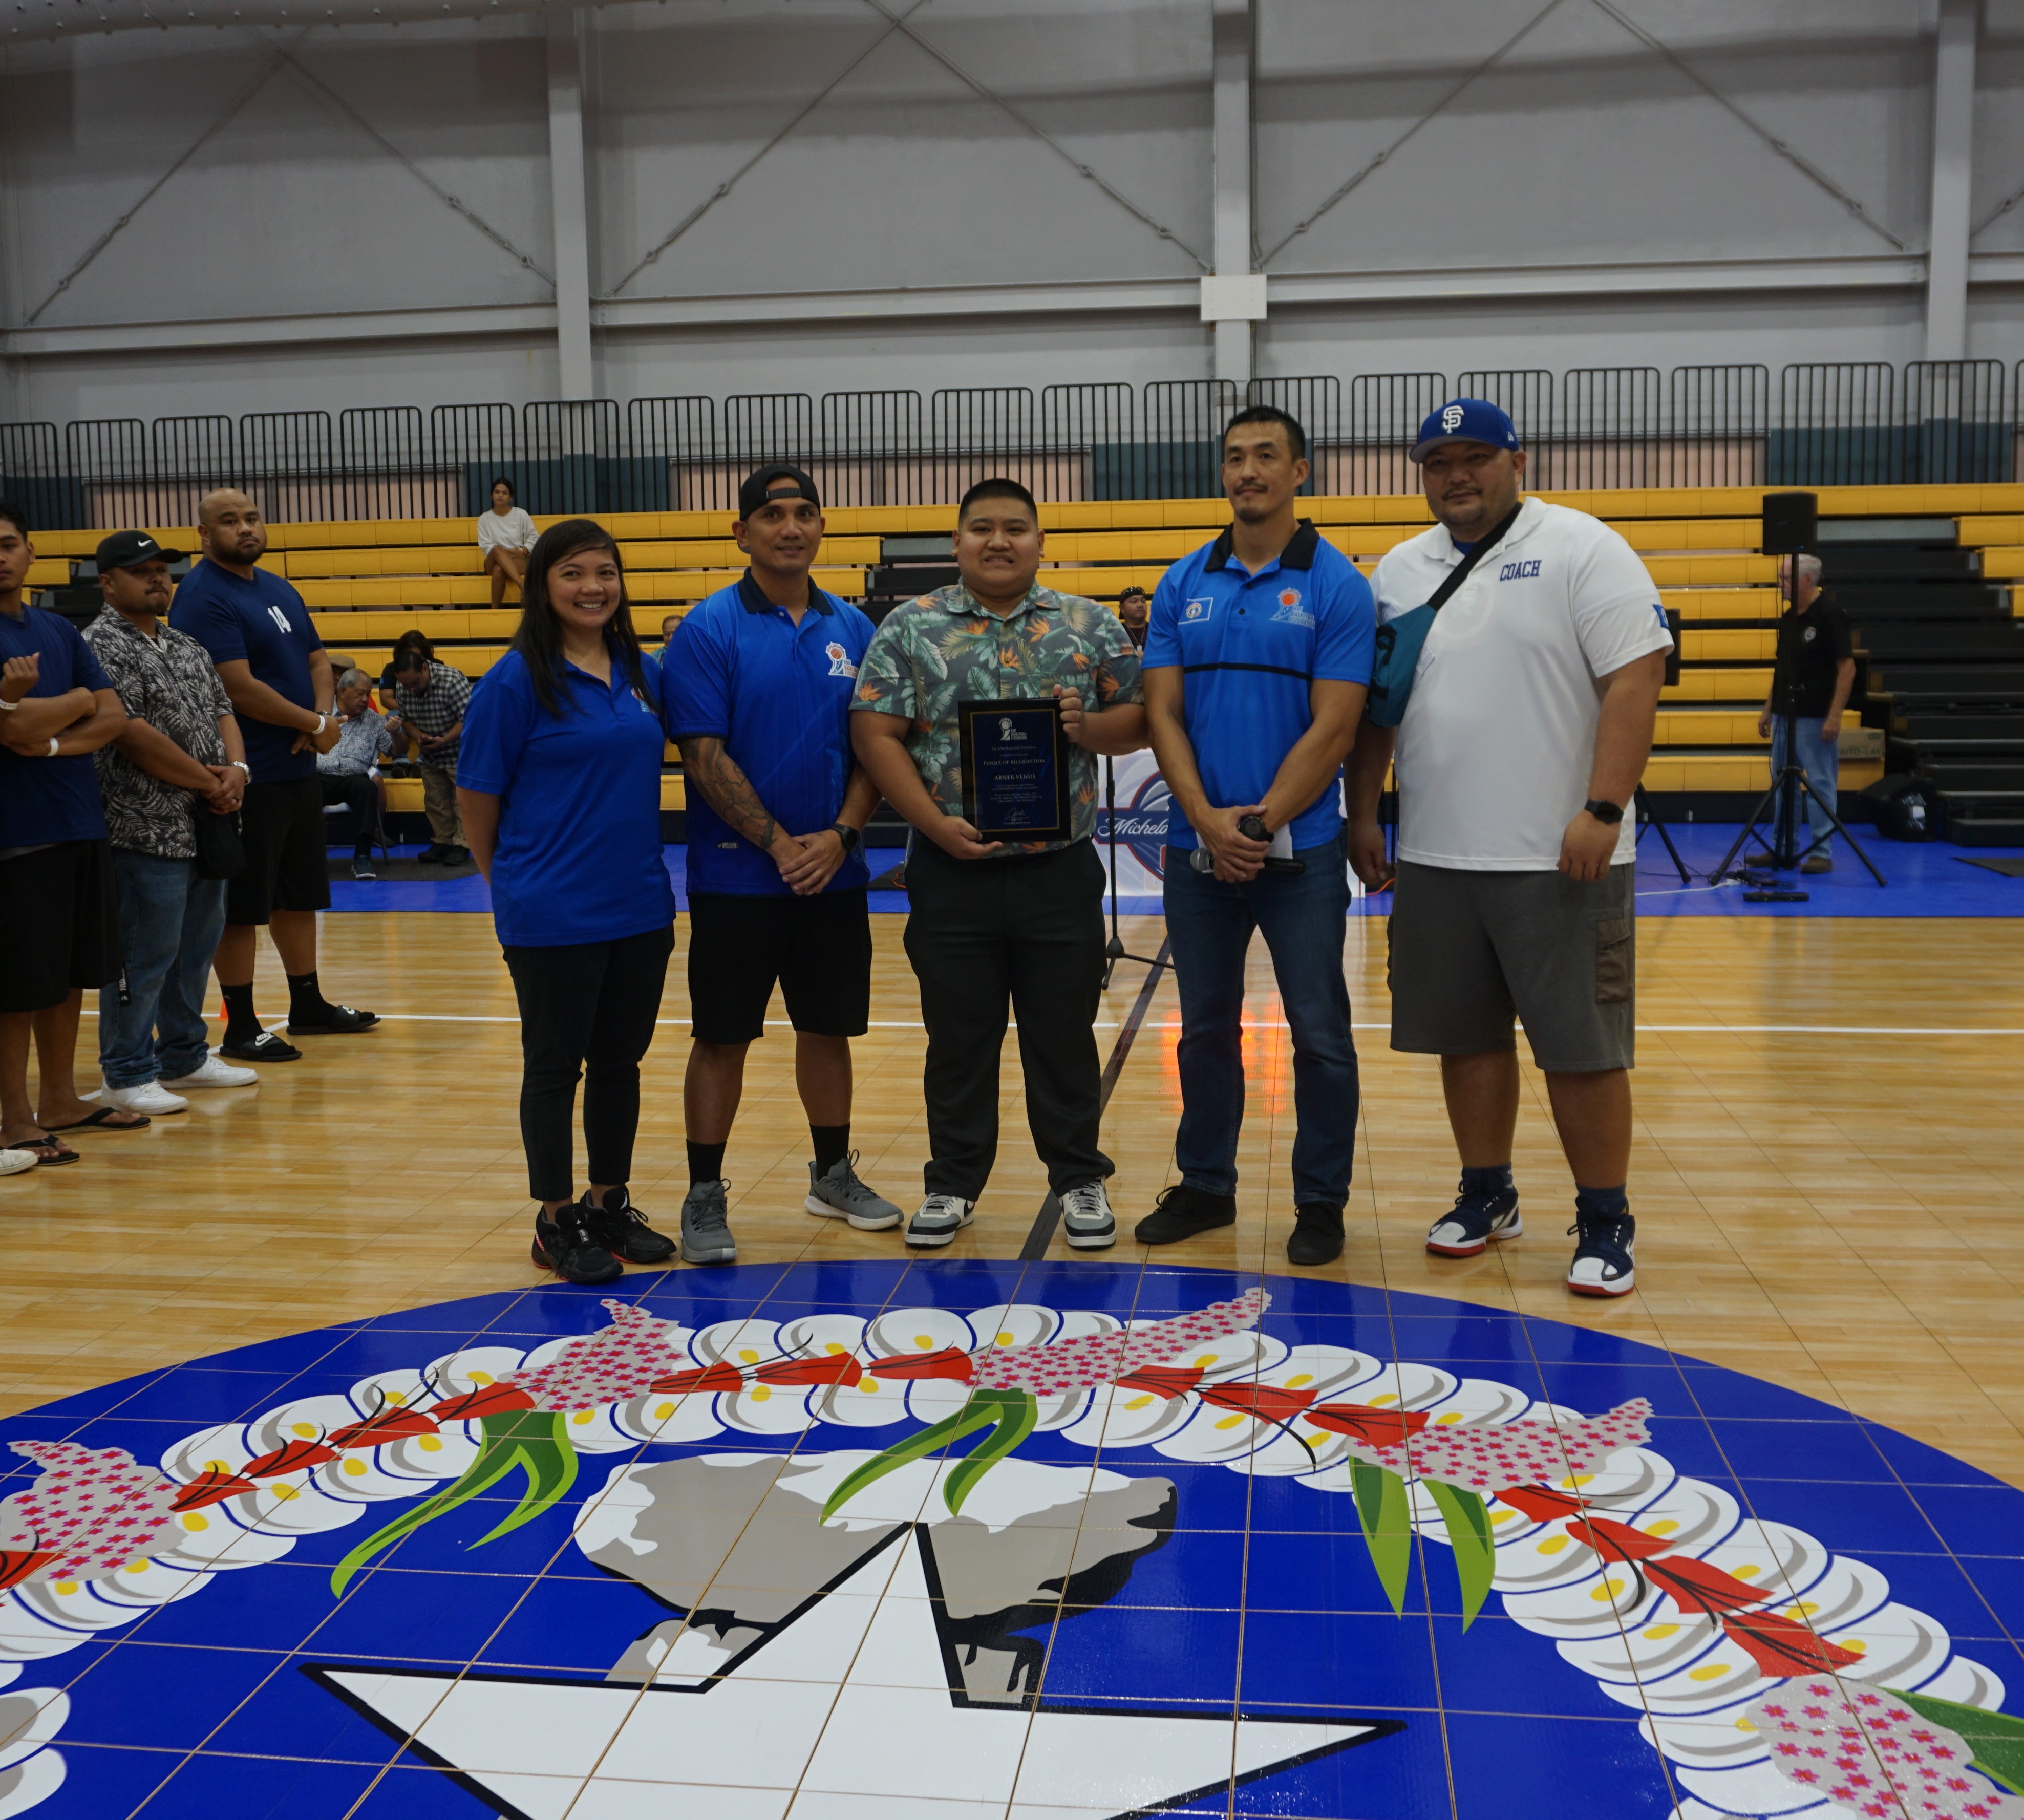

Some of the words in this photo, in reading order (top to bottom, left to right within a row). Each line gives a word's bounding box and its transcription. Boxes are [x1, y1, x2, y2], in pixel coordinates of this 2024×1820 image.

[1442, 405, 1464, 434] SF
[1500, 560, 1542, 582] COACH
[267, 605, 292, 633] 14
[1098, 818, 1169, 837] Michelo
[255, 1032, 272, 1042] NIKE
